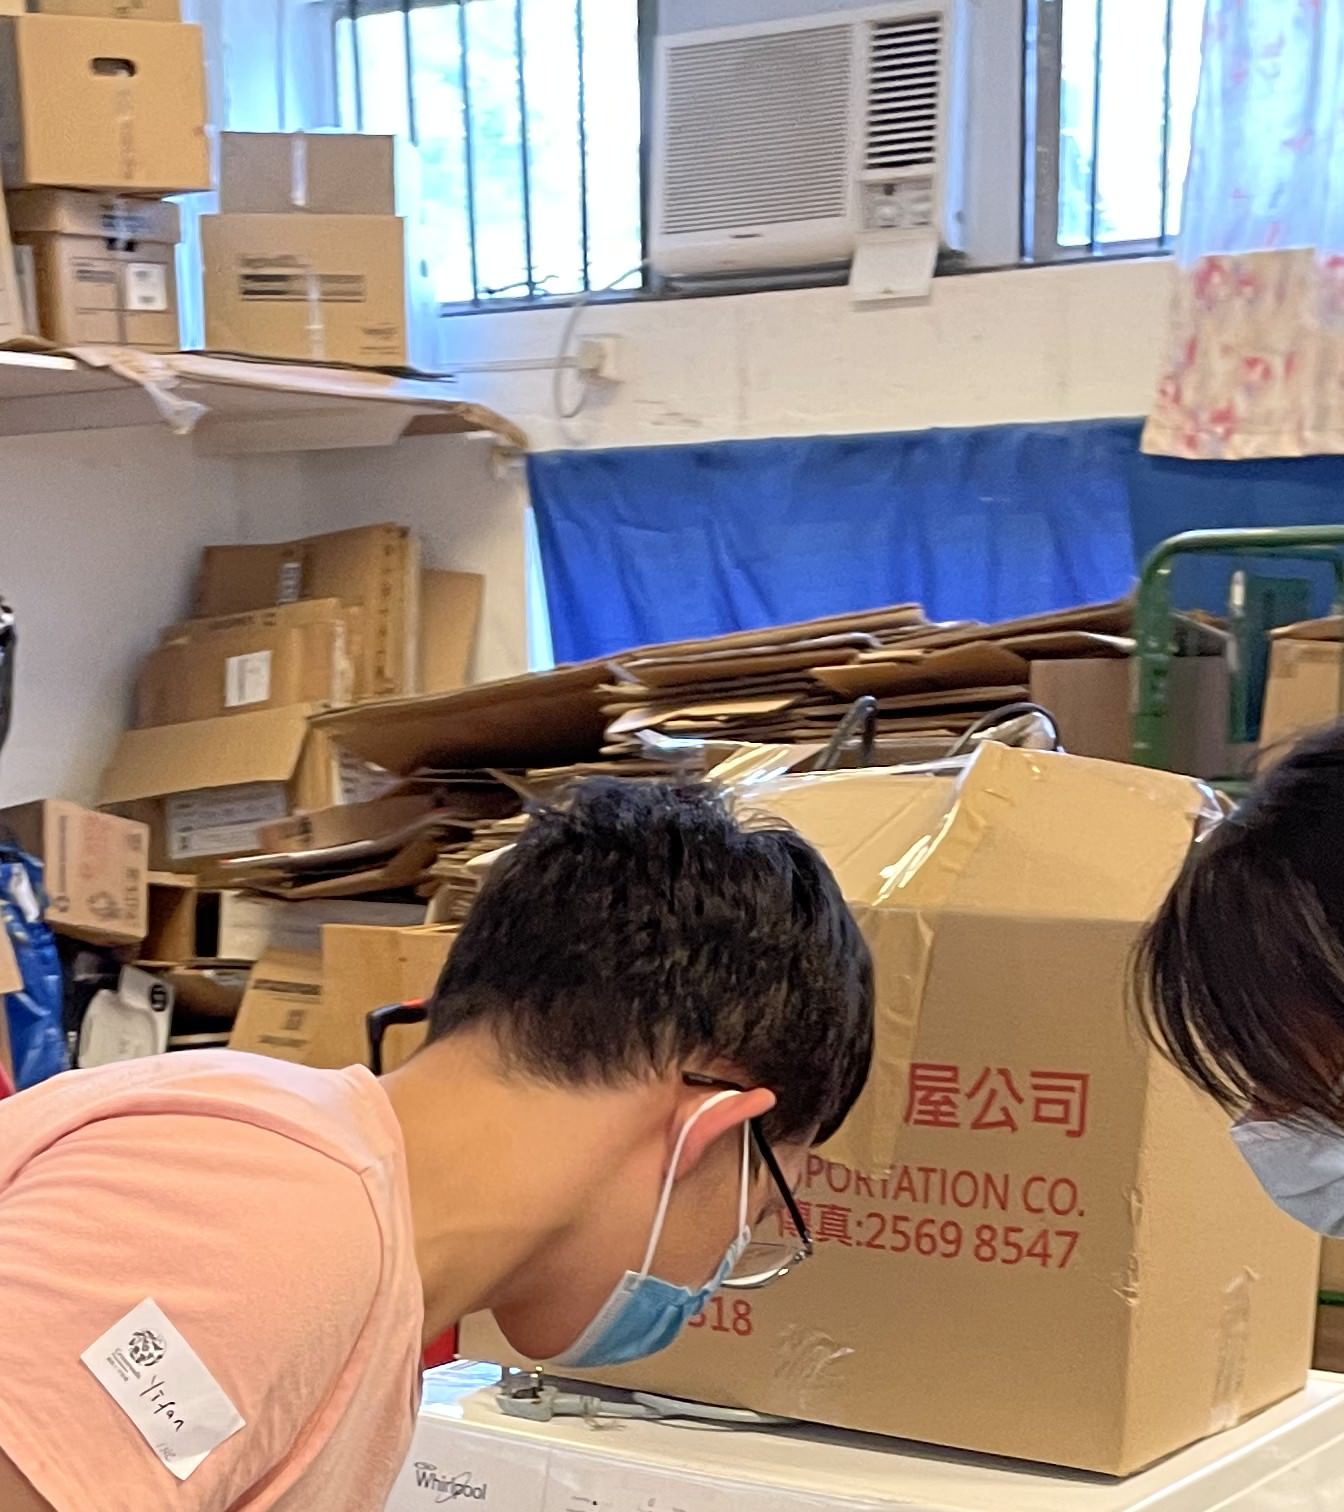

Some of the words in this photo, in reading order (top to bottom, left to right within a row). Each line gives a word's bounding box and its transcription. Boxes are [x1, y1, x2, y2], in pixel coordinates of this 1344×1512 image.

[905, 1062, 1090, 1138] 屋公司
[792, 1154, 1010, 1211] PORTATION
[1022, 1175, 1085, 1218] CO.
[973, 1223, 1080, 1269] 8547
[415, 1468, 488, 1501] Whirlpool
